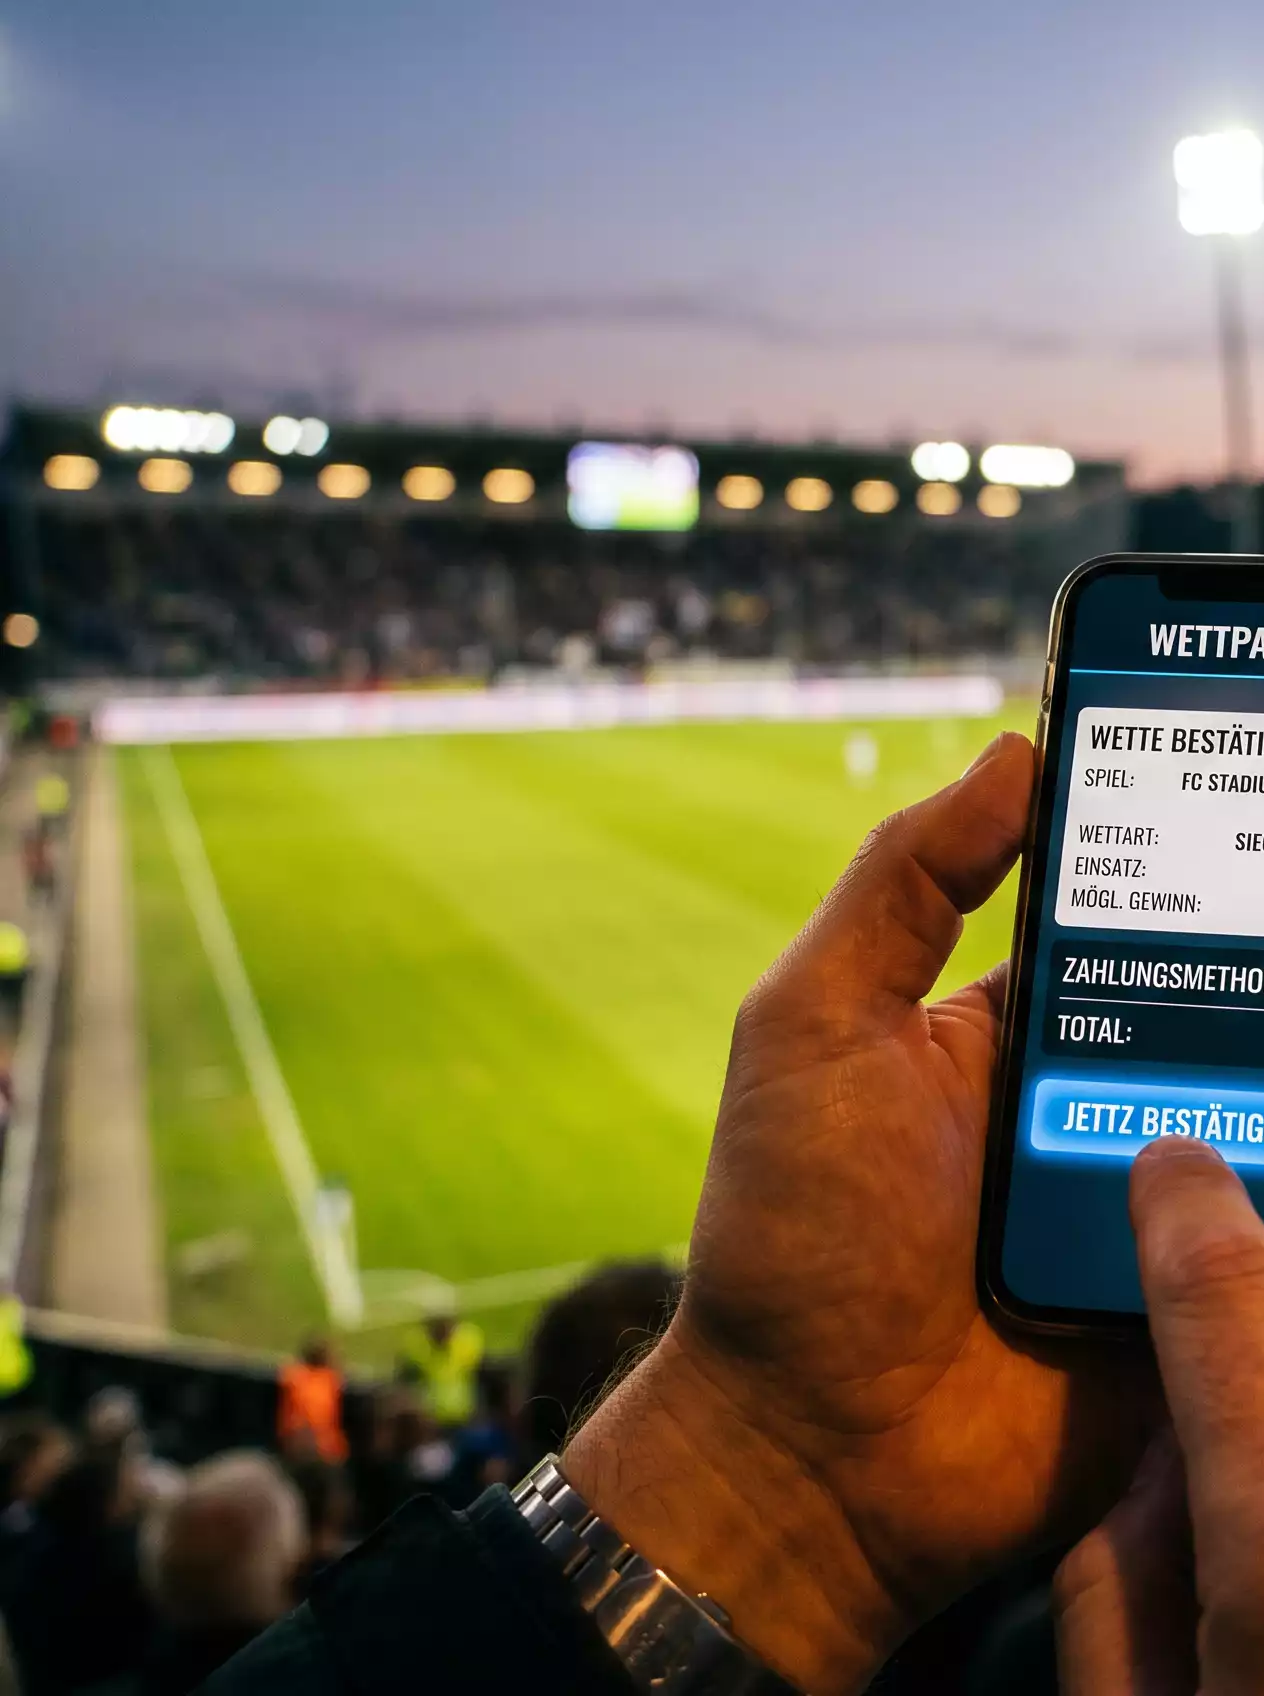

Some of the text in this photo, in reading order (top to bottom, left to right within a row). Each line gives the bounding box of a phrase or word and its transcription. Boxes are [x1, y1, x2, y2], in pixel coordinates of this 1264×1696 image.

[1091, 725, 1165, 752] WETTE
[1084, 768, 1135, 788] SPIEL:
[1181, 772, 1203, 791] FC
[1079, 824, 1159, 846] WETTART:
[1074, 856, 1146, 878] EINSATZ:
[1071, 885, 1123, 909] MÖGL.
[1129, 891, 1201, 913] GEWINN:
[1058, 1015, 1132, 1044] TOTAL:
[1063, 1102, 1135, 1135] JETTZ
